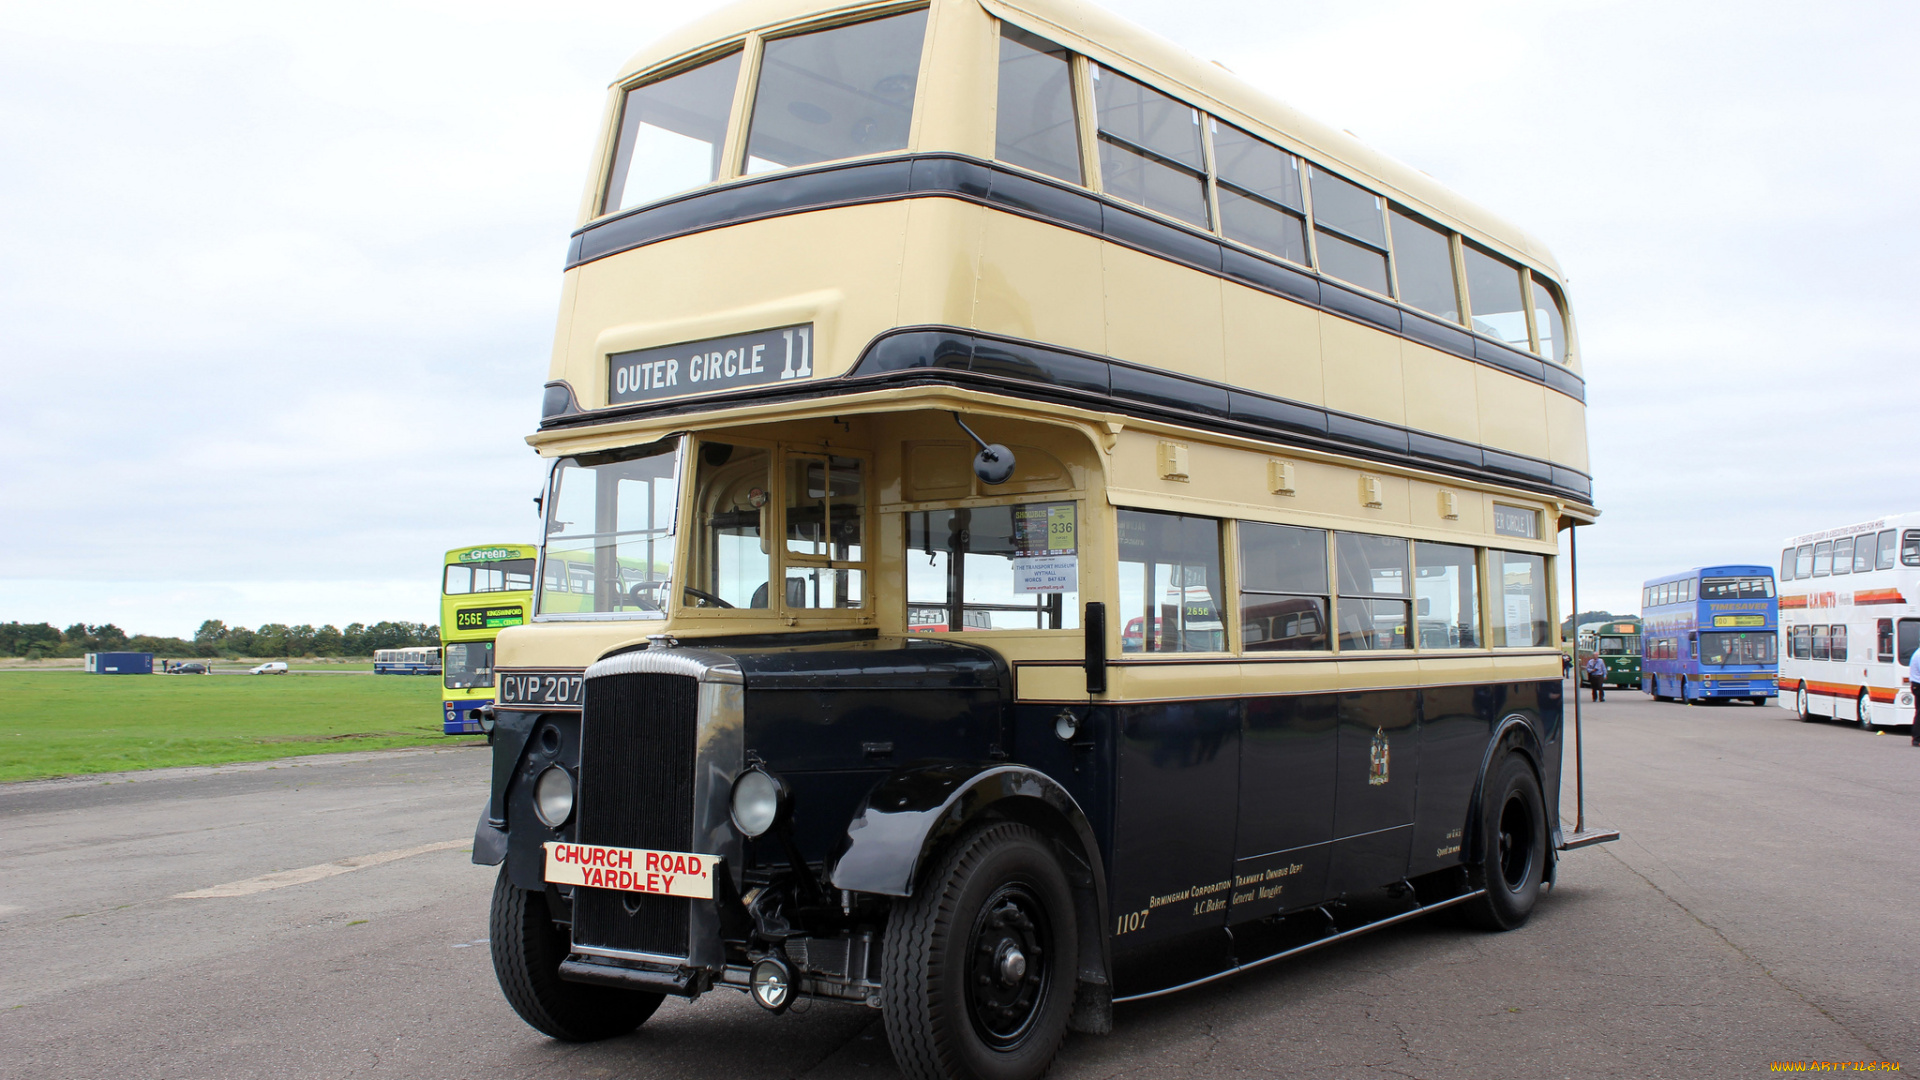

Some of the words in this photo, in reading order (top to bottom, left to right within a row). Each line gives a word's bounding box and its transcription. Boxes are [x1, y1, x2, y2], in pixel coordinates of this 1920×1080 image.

[616, 359, 678, 394] OUTER
[689, 344, 765, 382] CIRCLE
[780, 328, 811, 379] 11
[1051, 522, 1073, 533] 336
[471, 550, 507, 559] Green
[458, 612, 482, 625] 256E
[1710, 602, 1768, 610] TIMESAVER
[504, 676, 540, 701] CVP
[544, 677, 582, 702] 207
[555, 844, 632, 869] CHURCH
[646, 852, 707, 879] ROAD,
[581, 866, 675, 893] YARDLEY
[1116, 909, 1149, 935] 1107
